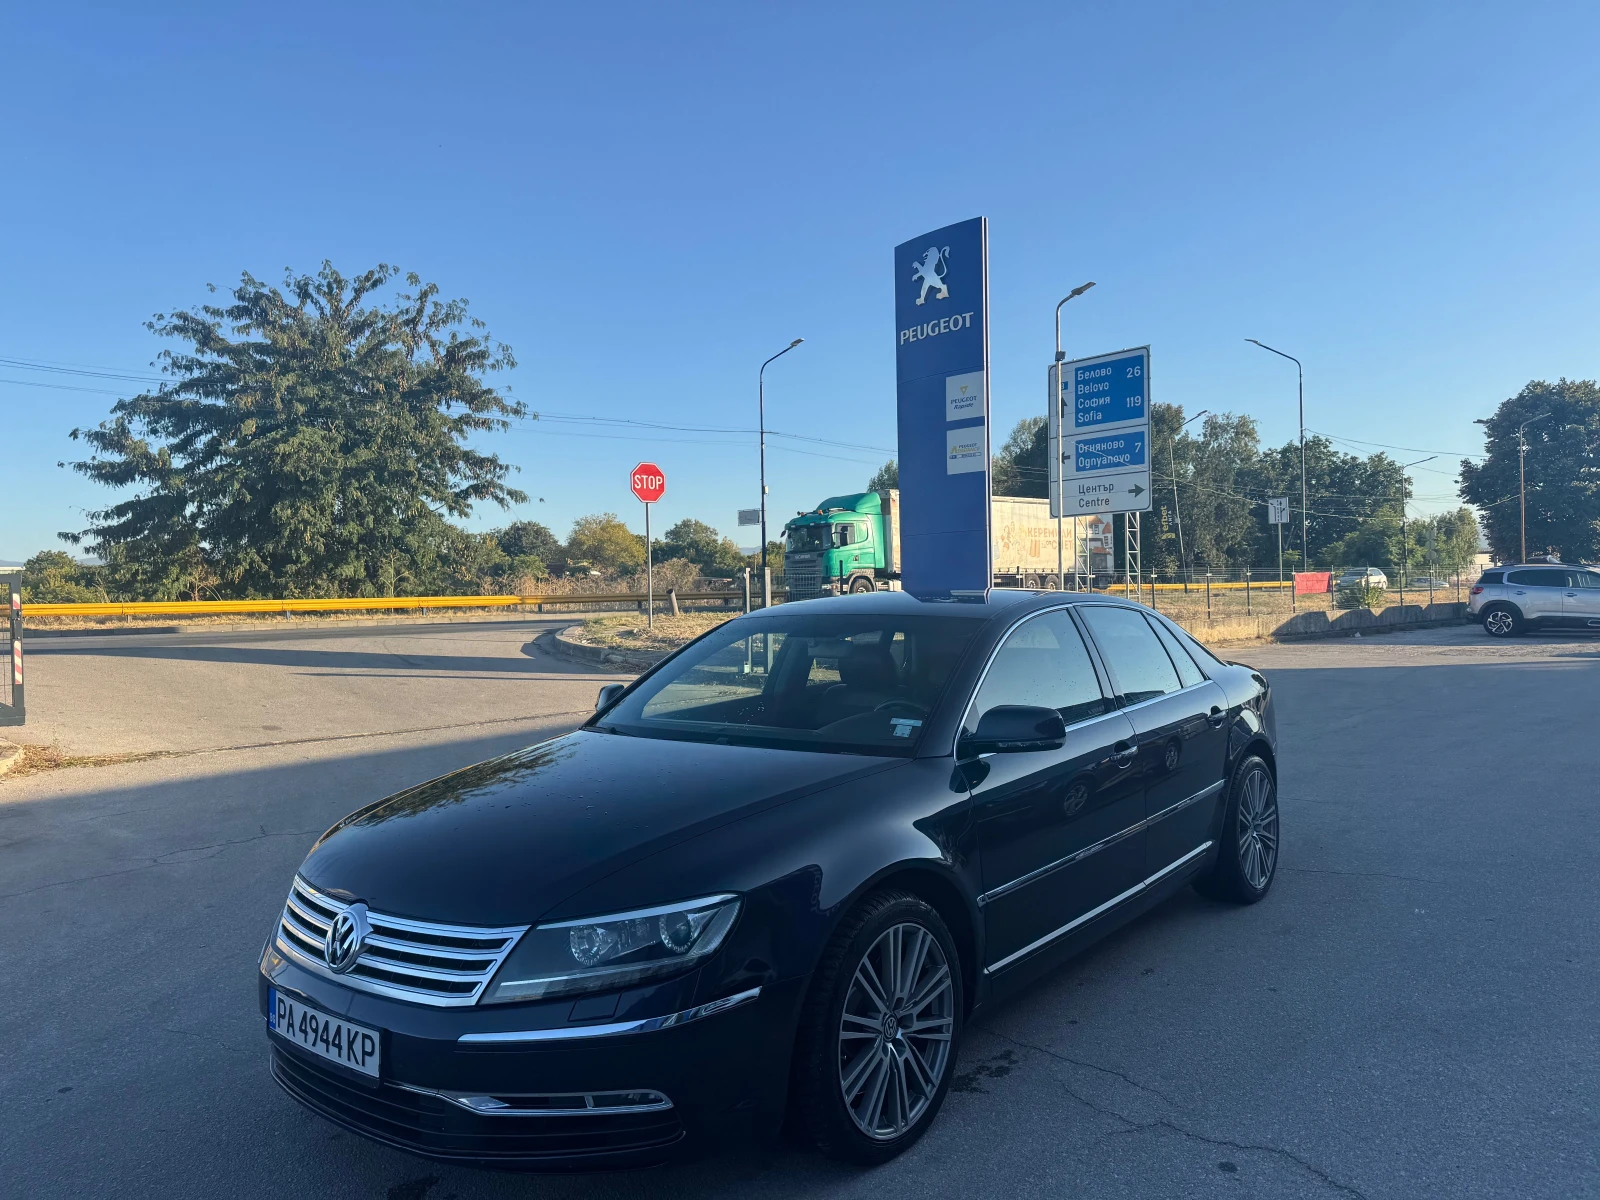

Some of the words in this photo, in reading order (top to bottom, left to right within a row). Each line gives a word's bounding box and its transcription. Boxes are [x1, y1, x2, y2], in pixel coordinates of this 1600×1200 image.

[900, 312, 974, 345] PEUGEOT
[1077, 367, 1112, 381] Белово
[1126, 366, 1141, 379] 26
[1077, 382, 1110, 395] Belovo
[950, 395, 977, 404] PEUGEOT
[1077, 396, 1111, 409] София
[1126, 395, 1142, 408] 119
[1077, 411, 1102, 423] Sofia
[1078, 440, 1125, 453] Огняново
[1134, 442, 1142, 453] 7
[1078, 454, 1131, 469] Ognyanovo
[634, 474, 663, 490] STOP
[1078, 483, 1115, 495] Център
[1078, 497, 1110, 508] Centre
[1160, 505, 1169, 531] efbet
